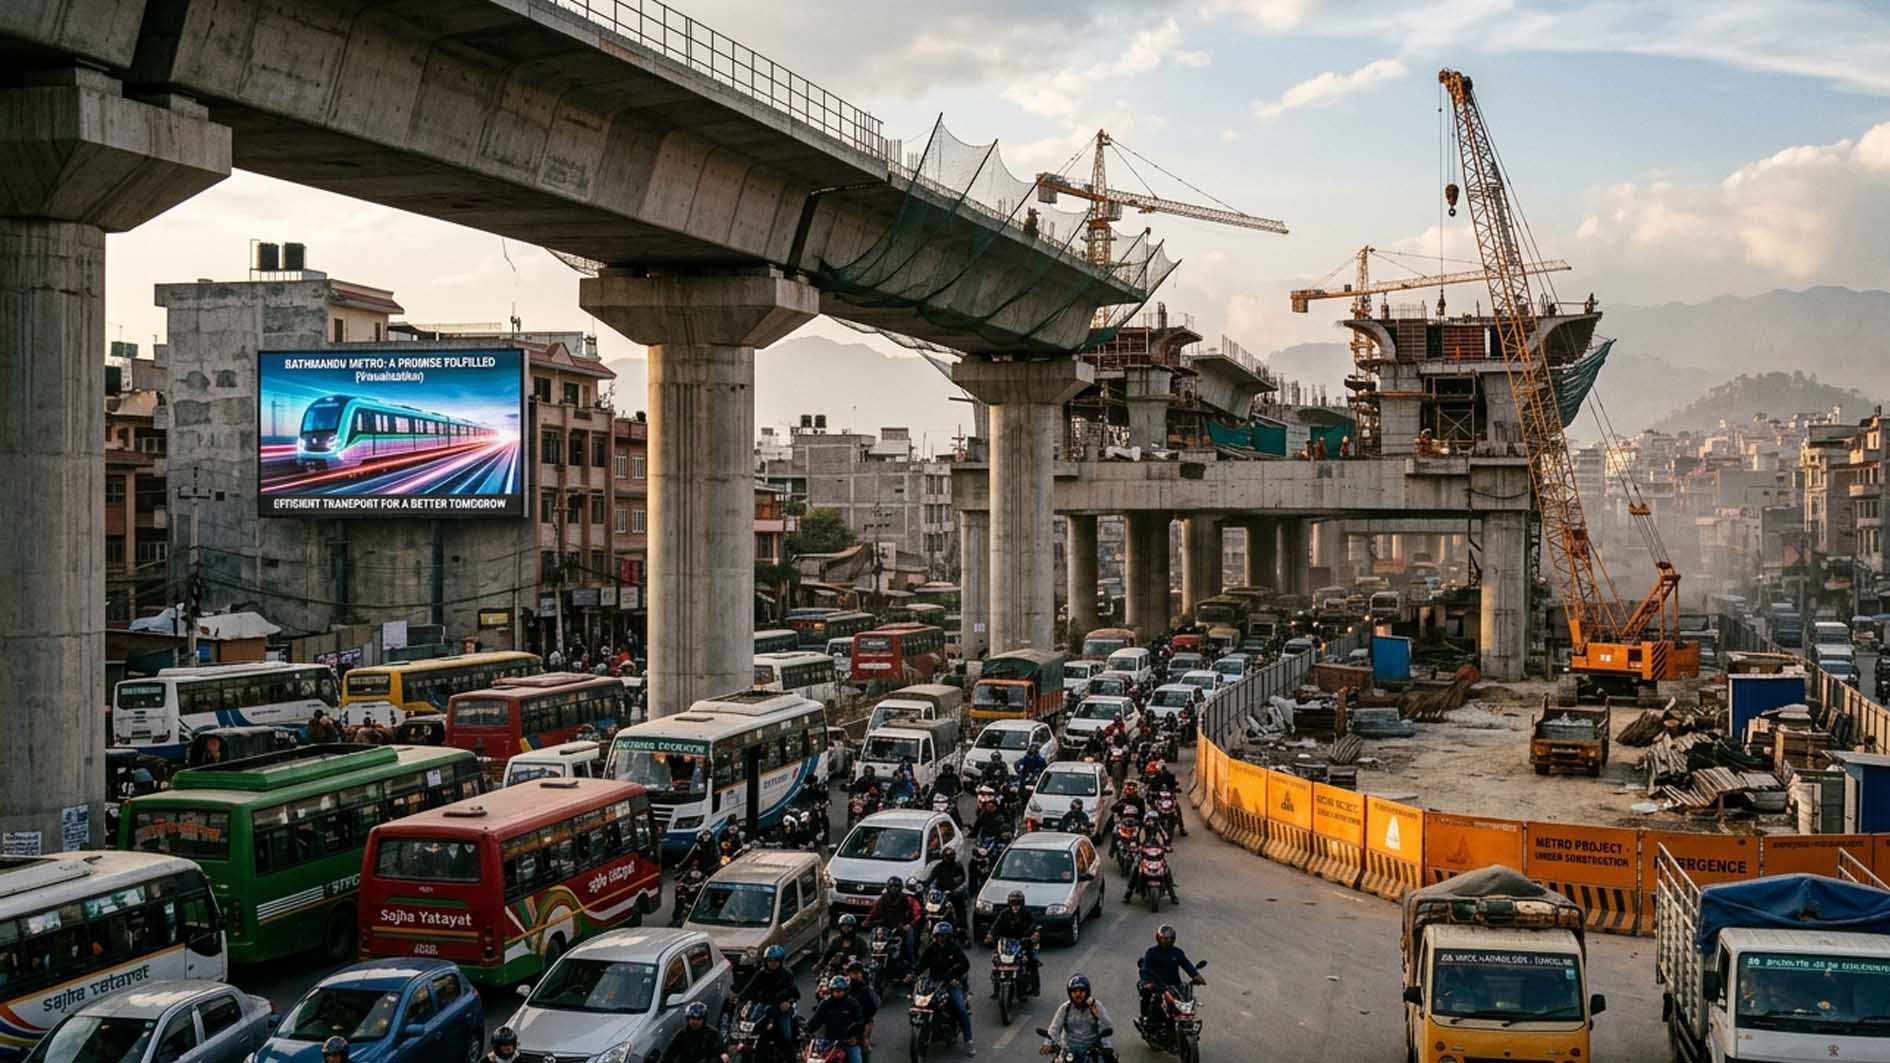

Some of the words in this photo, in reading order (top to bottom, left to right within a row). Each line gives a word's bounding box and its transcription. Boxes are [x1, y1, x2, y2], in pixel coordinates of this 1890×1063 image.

[388, 358, 396, 368] A
[380, 498, 400, 509] FOR
[401, 498, 409, 509] A
[1535, 836, 1572, 851] METRO
[380, 909, 416, 926] Sajha
[418, 911, 472, 929] Yatayat
